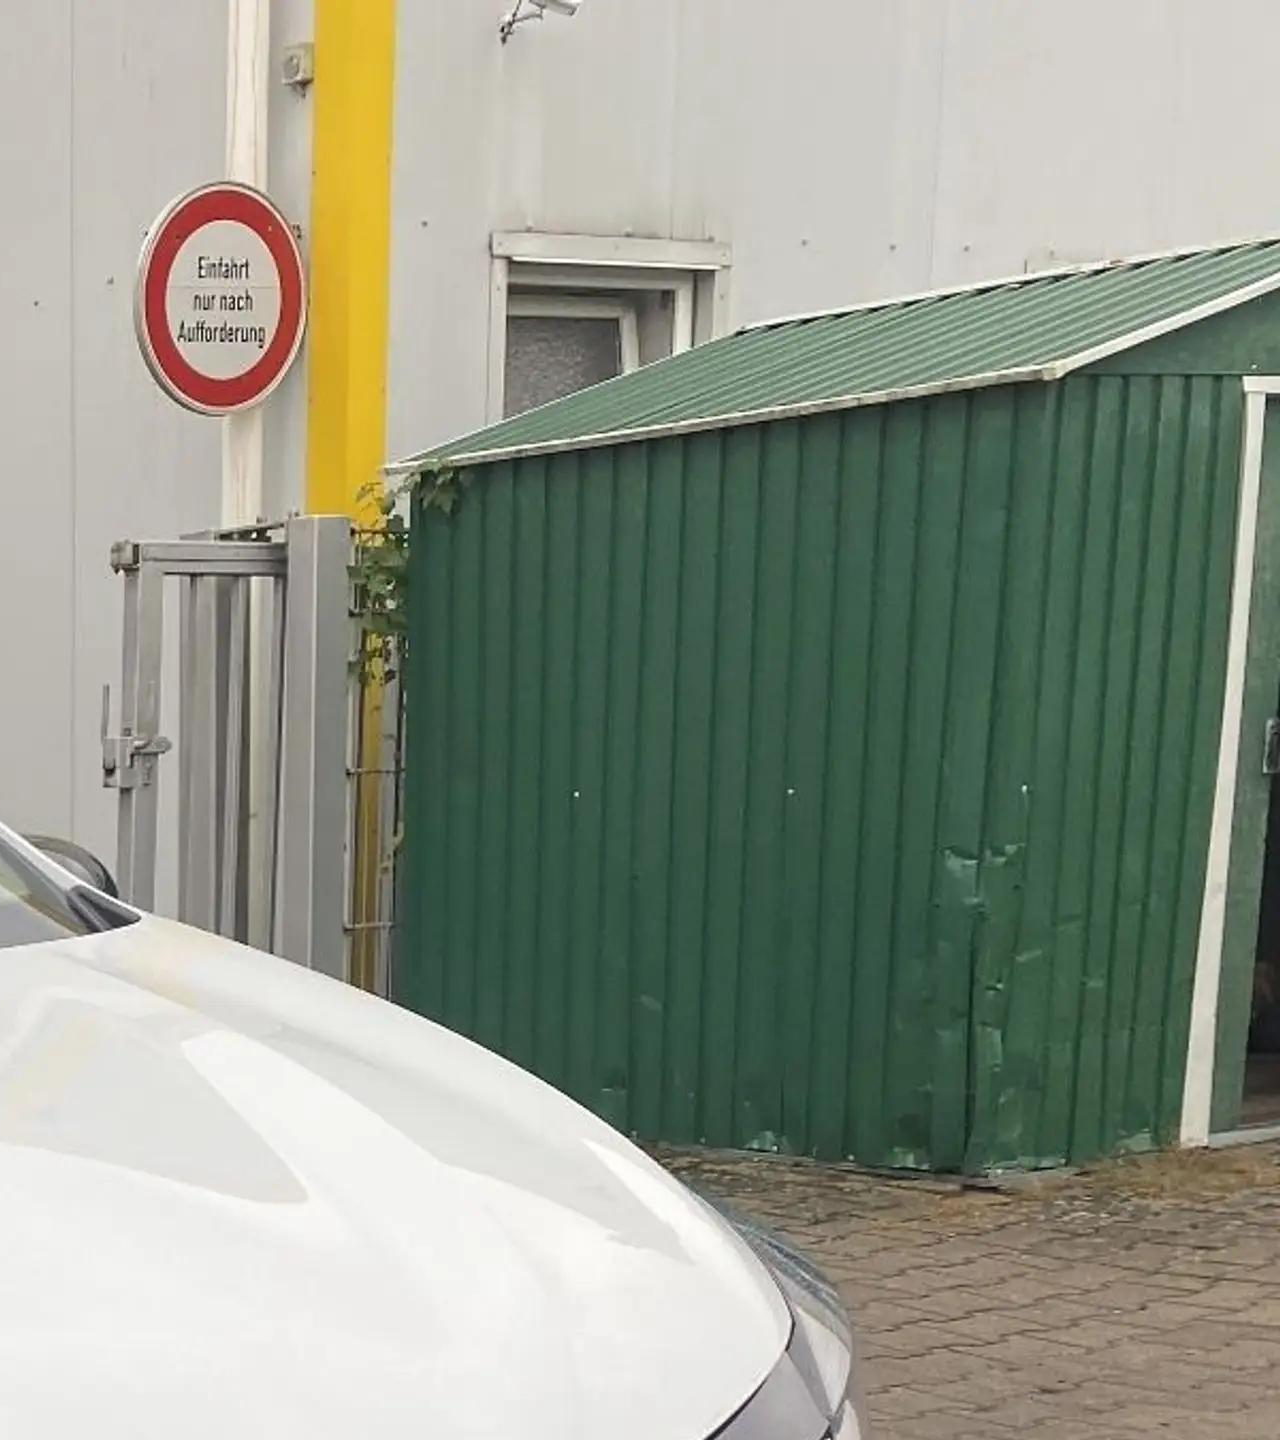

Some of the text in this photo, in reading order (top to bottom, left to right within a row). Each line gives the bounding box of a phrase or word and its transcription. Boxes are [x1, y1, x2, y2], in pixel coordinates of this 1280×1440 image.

[197, 256, 249, 280] Einfahrt
[193, 289, 254, 311] nur nach
[177, 320, 266, 349] Aufforderung
